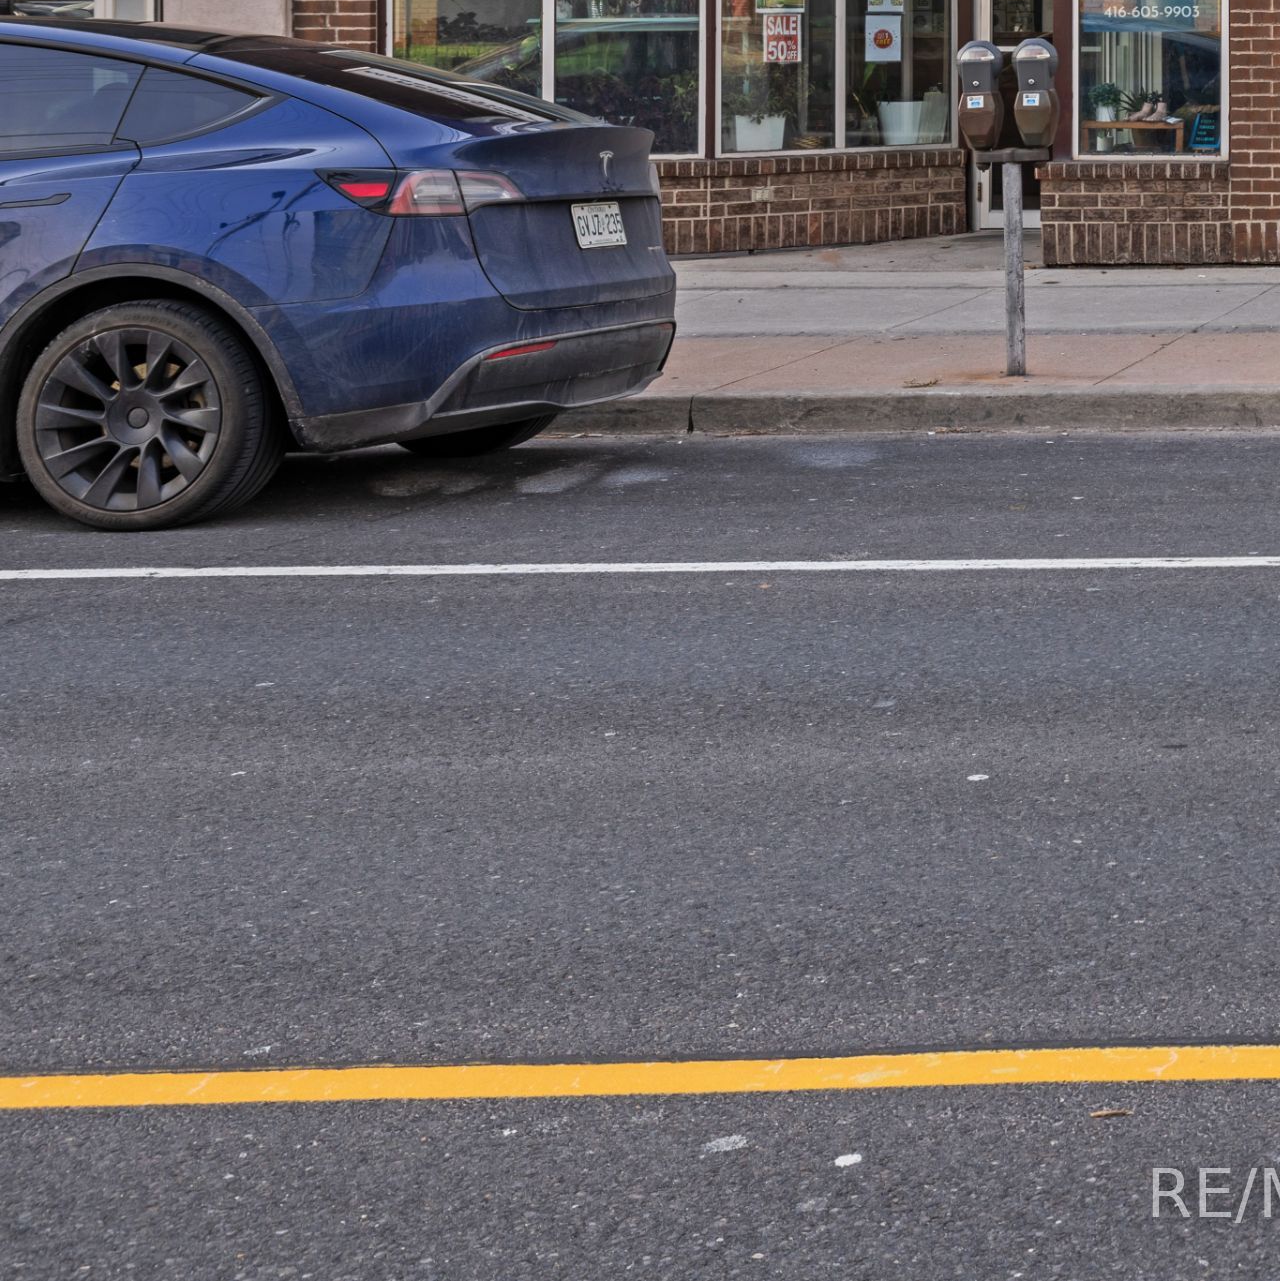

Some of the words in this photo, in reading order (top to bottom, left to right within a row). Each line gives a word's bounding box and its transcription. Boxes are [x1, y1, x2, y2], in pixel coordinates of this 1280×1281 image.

[1104, 6, 1200, 18] 416-605-9903
[767, 16, 797, 35] SALE
[787, 51, 798, 60] OFF
